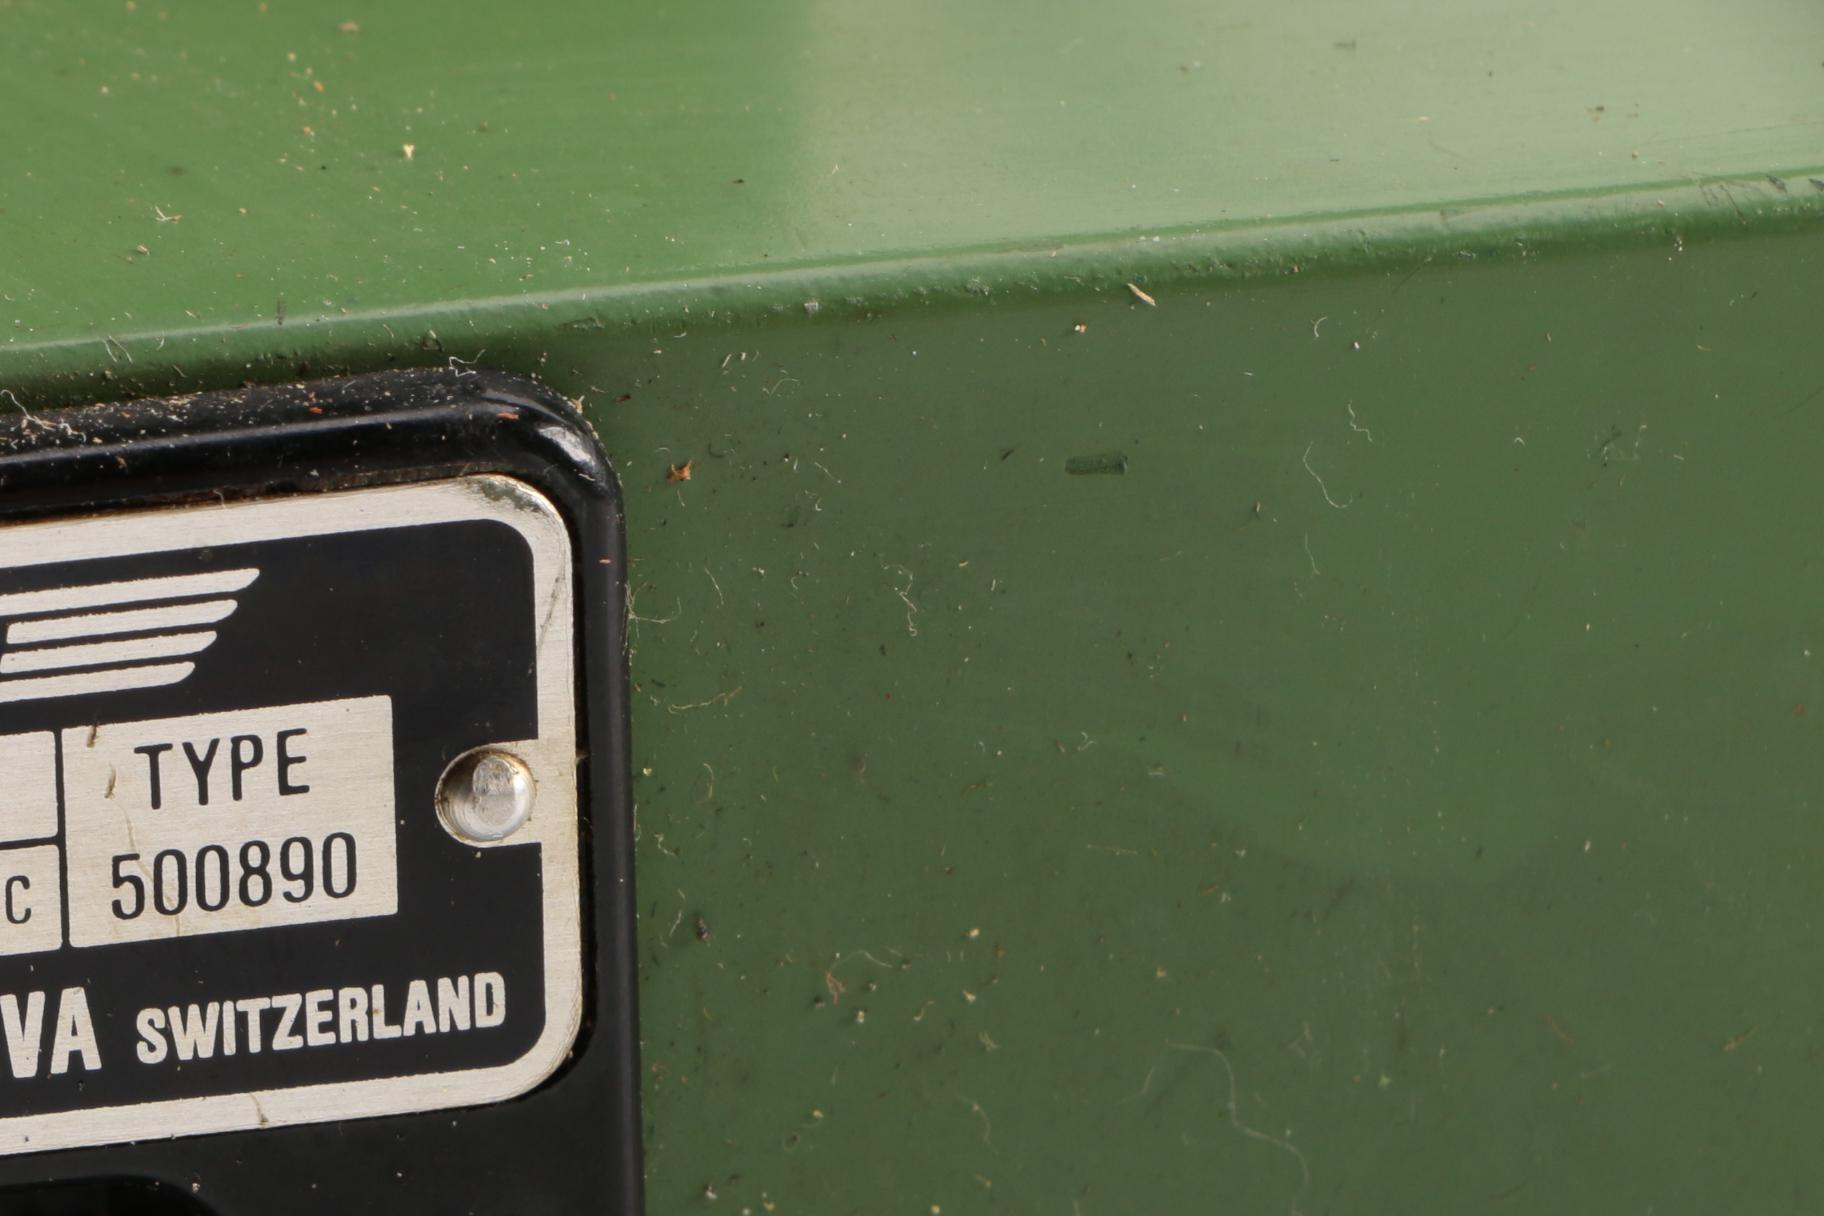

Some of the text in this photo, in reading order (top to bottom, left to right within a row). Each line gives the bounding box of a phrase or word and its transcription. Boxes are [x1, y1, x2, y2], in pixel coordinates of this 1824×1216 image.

[133, 728, 311, 810] TYPE
[110, 832, 358, 921] 500890
[135, 971, 507, 1066] SWITZERLAND
